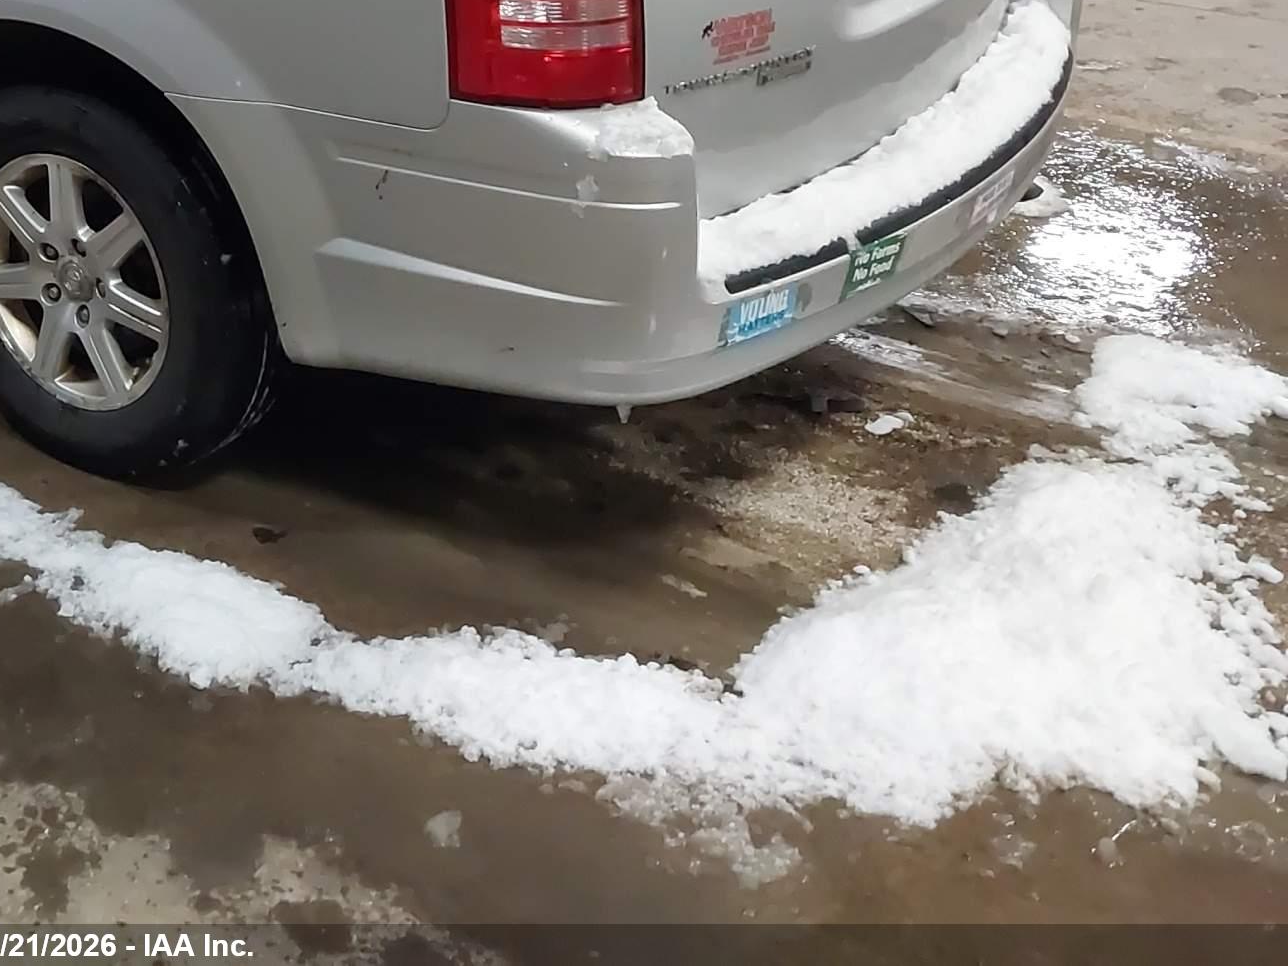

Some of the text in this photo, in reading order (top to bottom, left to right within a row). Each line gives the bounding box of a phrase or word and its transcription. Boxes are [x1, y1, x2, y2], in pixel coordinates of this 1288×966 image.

[855, 242, 901, 266] No Farms
[853, 256, 895, 282] No Food
